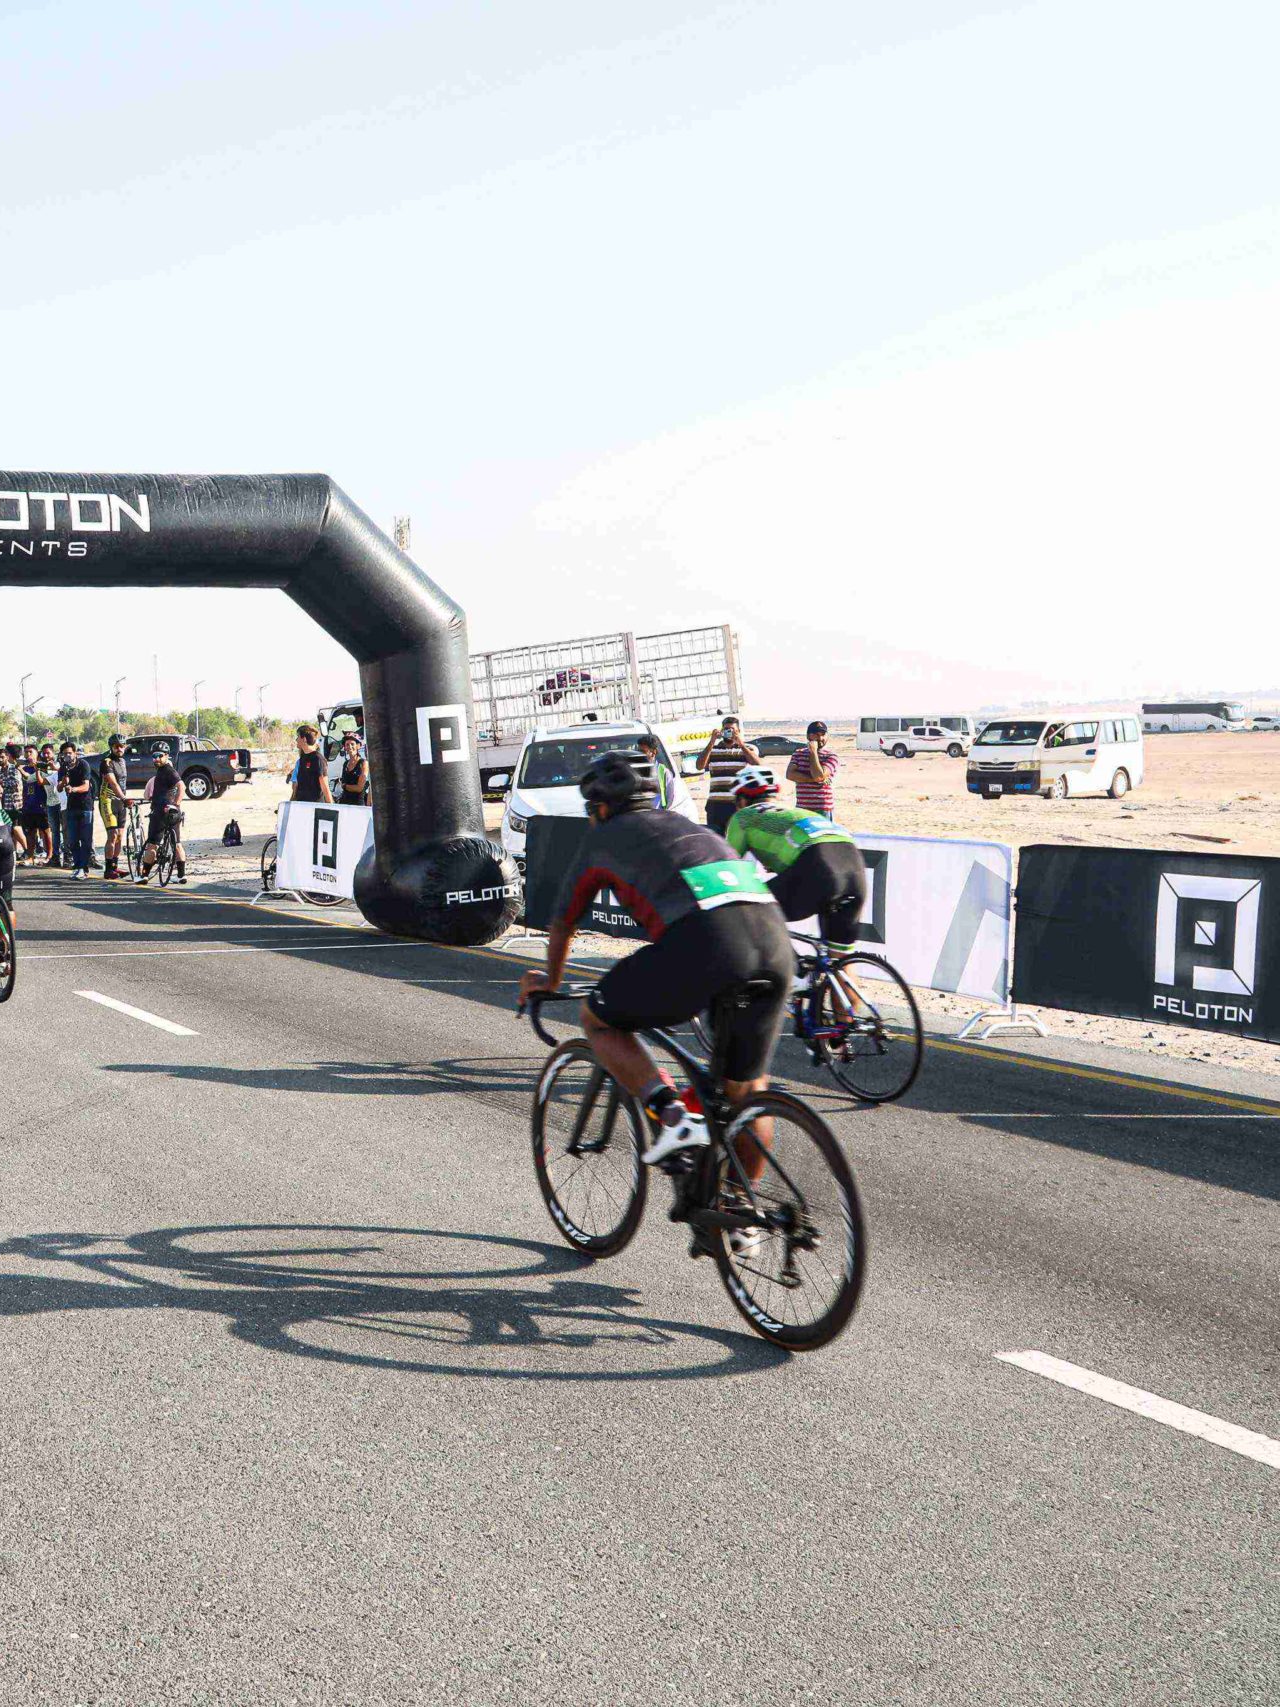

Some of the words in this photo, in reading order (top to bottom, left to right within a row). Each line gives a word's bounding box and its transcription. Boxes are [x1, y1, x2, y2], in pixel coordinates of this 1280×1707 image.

[312, 870, 337, 883] PELOTON
[445, 881, 520, 905] PELOTON
[1153, 994, 1253, 1024] PELOTON
